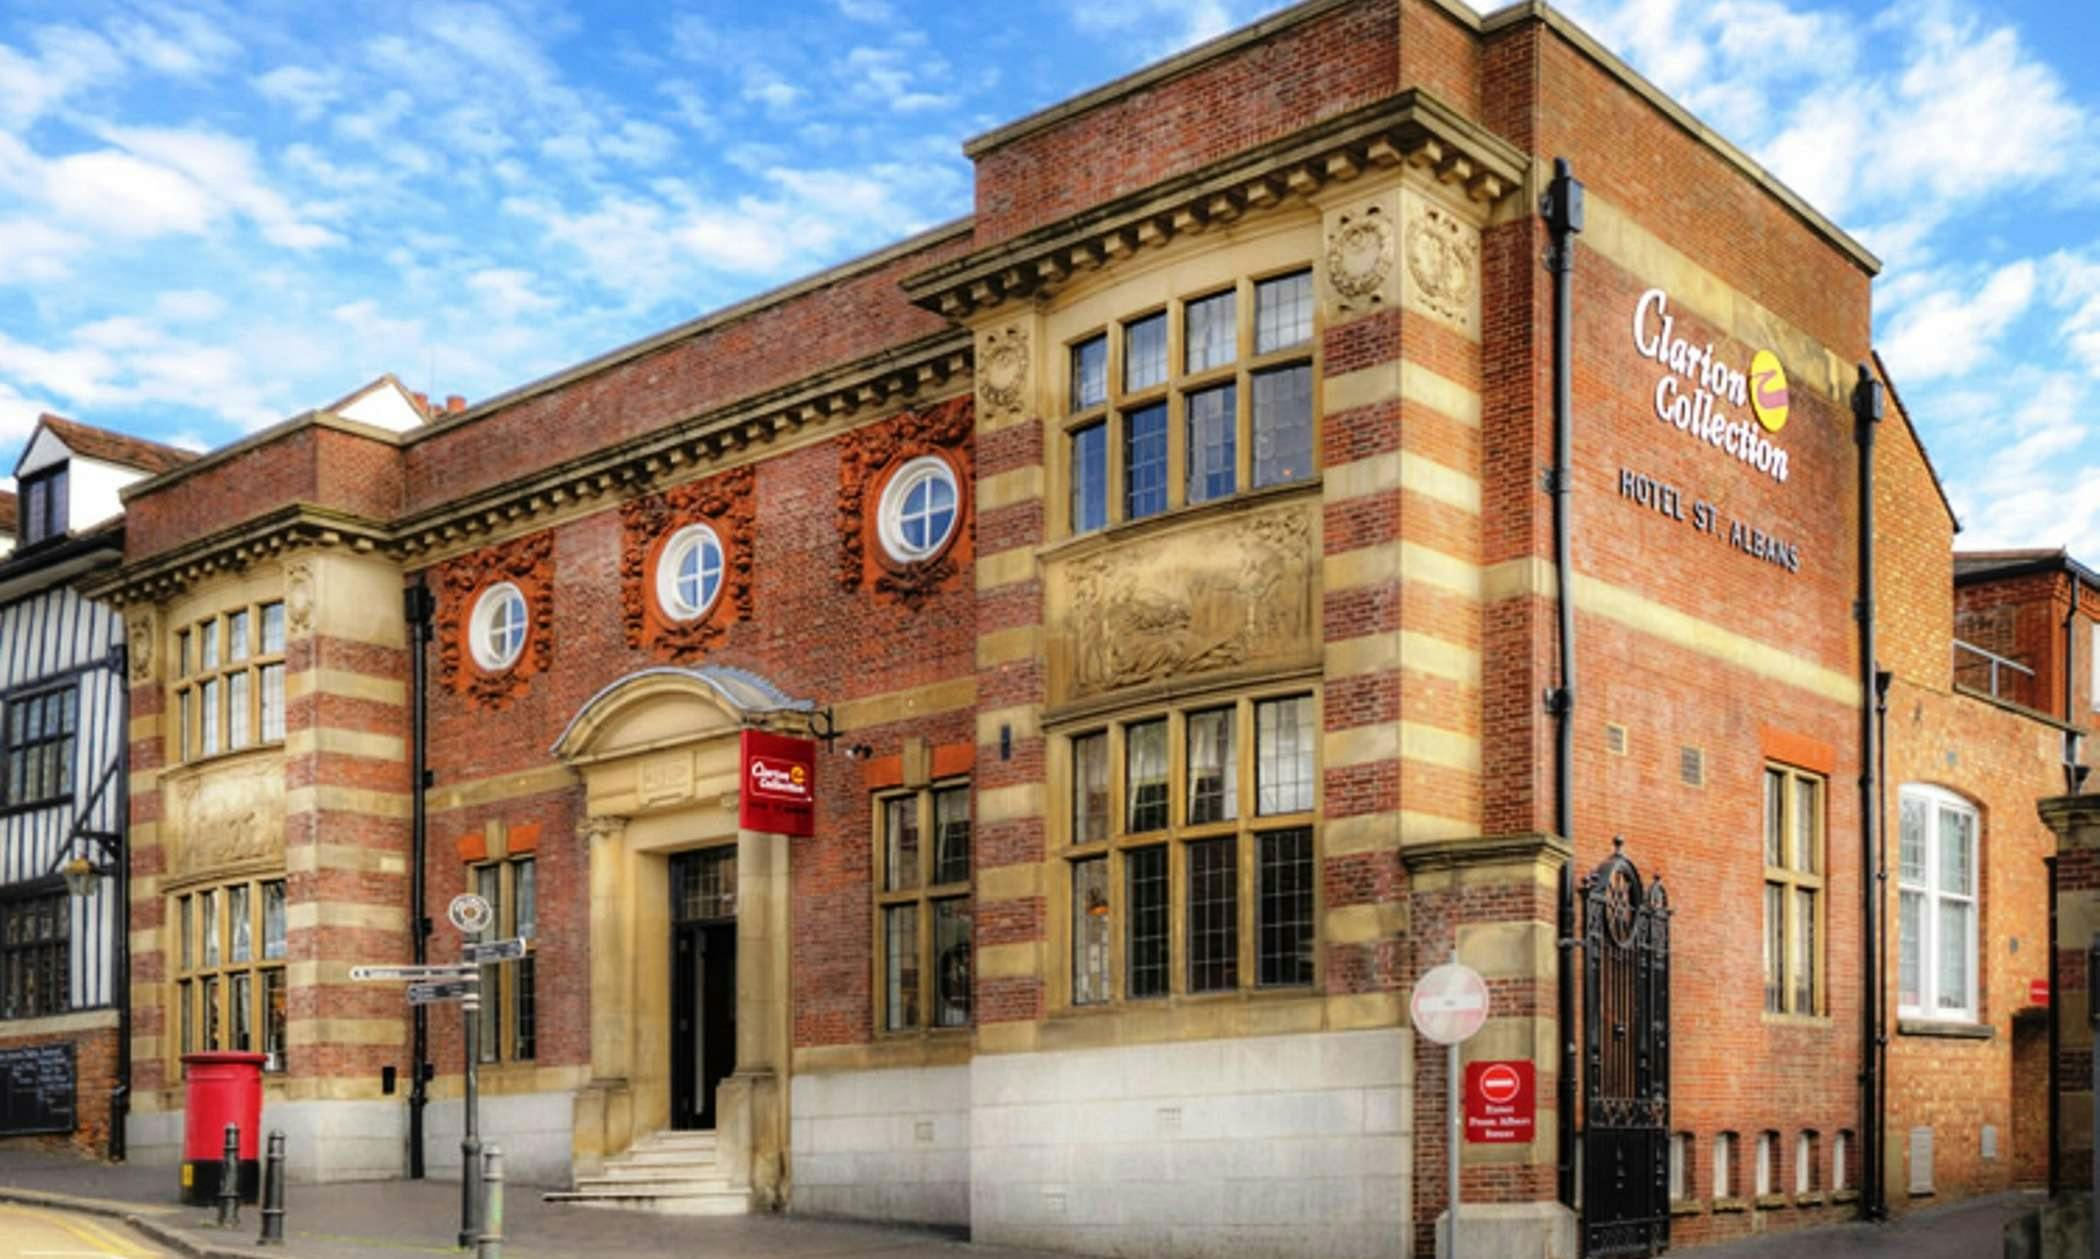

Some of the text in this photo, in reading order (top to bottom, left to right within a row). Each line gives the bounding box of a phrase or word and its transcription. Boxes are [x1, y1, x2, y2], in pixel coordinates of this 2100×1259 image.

[1633, 288, 1747, 407] Clarion
[1655, 376, 1789, 482] Collection
[1619, 468, 1800, 574] HOTEL ST. ALBANS
